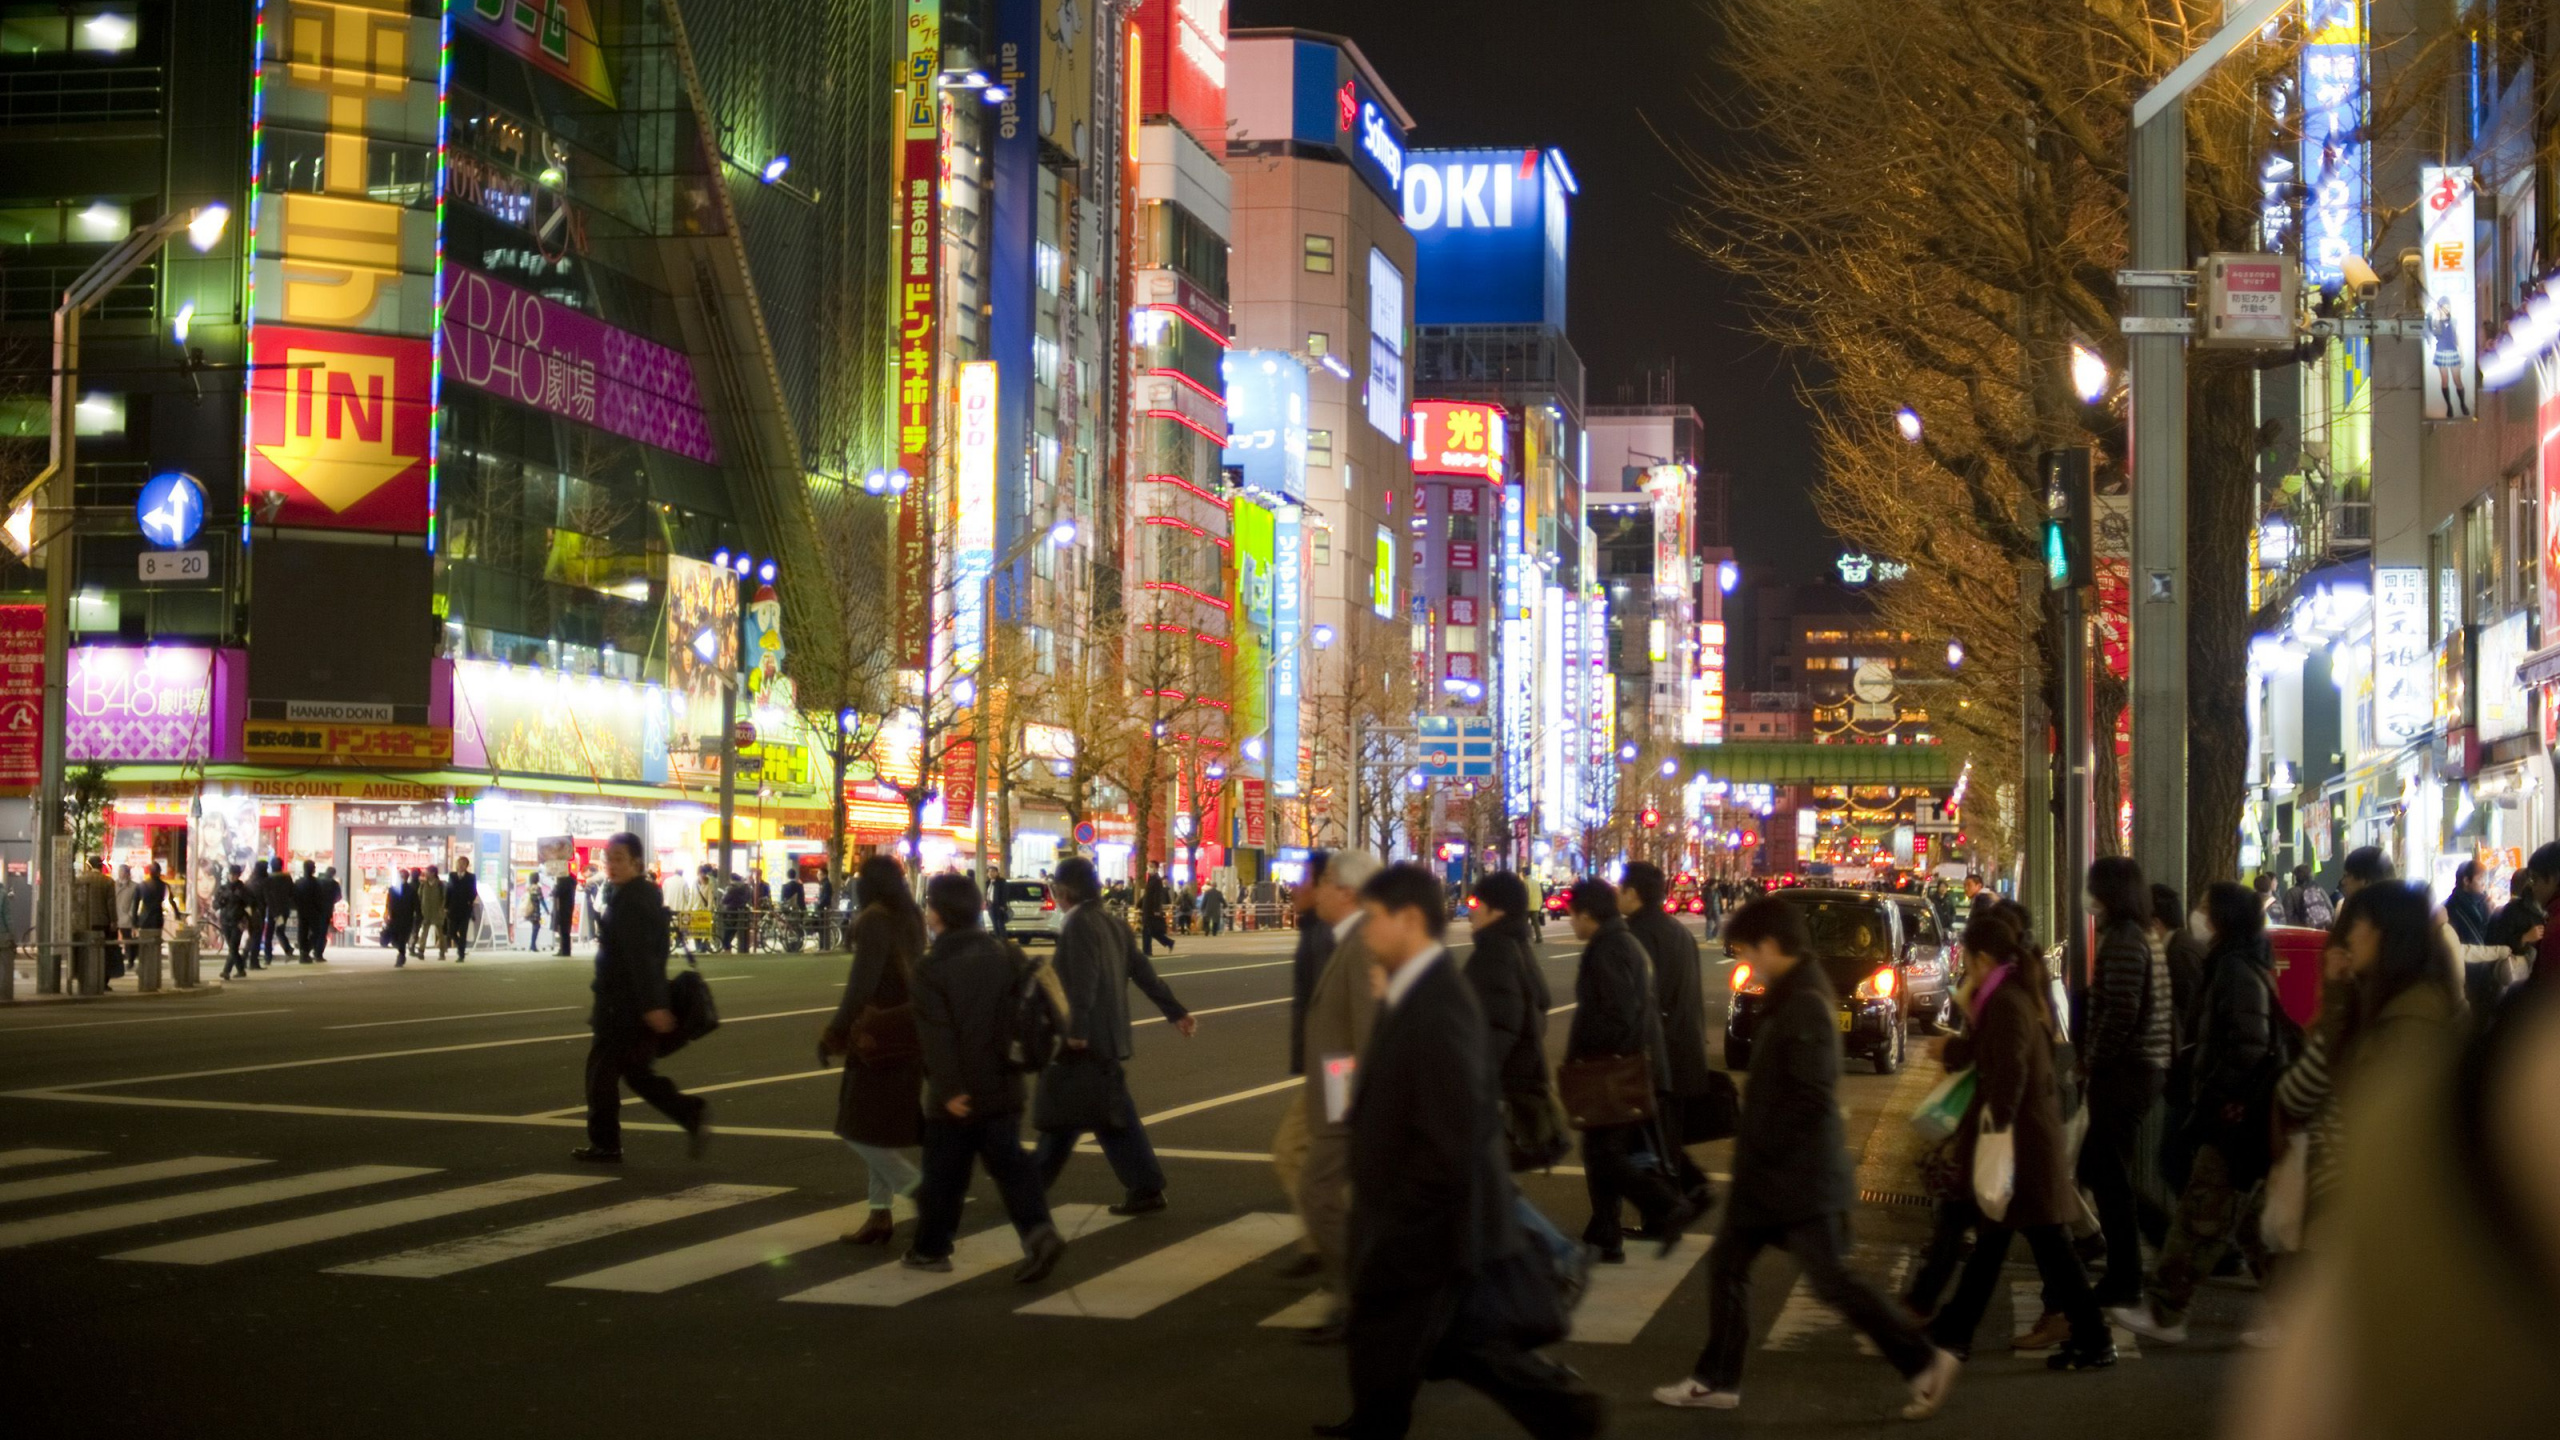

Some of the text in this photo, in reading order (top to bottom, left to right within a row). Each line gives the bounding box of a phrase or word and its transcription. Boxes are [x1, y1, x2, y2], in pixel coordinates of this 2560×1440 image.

[910, 14, 927, 28] 6F
[920, 28, 939, 42] 7F
[909, 49, 938, 127] ゲーム
[1001, 42, 1023, 139] animate
[1403, 162, 1513, 231] OKI
[2319, 180, 2351, 266] DVD
[903, 180, 931, 454] 激安の殿堂 ドン・キホーテ
[2231, 294, 2276, 303] 防犯カメラ
[2241, 304, 2268, 313] 作動中
[296, 366, 384, 443] IN
[1447, 409, 1484, 451] 光
[146, 558, 156, 575] 8
[181, 557, 201, 573] 20
[1279, 536, 1297, 610] ソフマップ
[1450, 488, 1474, 681] 愛三電機
[290, 705, 388, 719] HANARO DON KI
[253, 781, 343, 796] DISCOUNT
